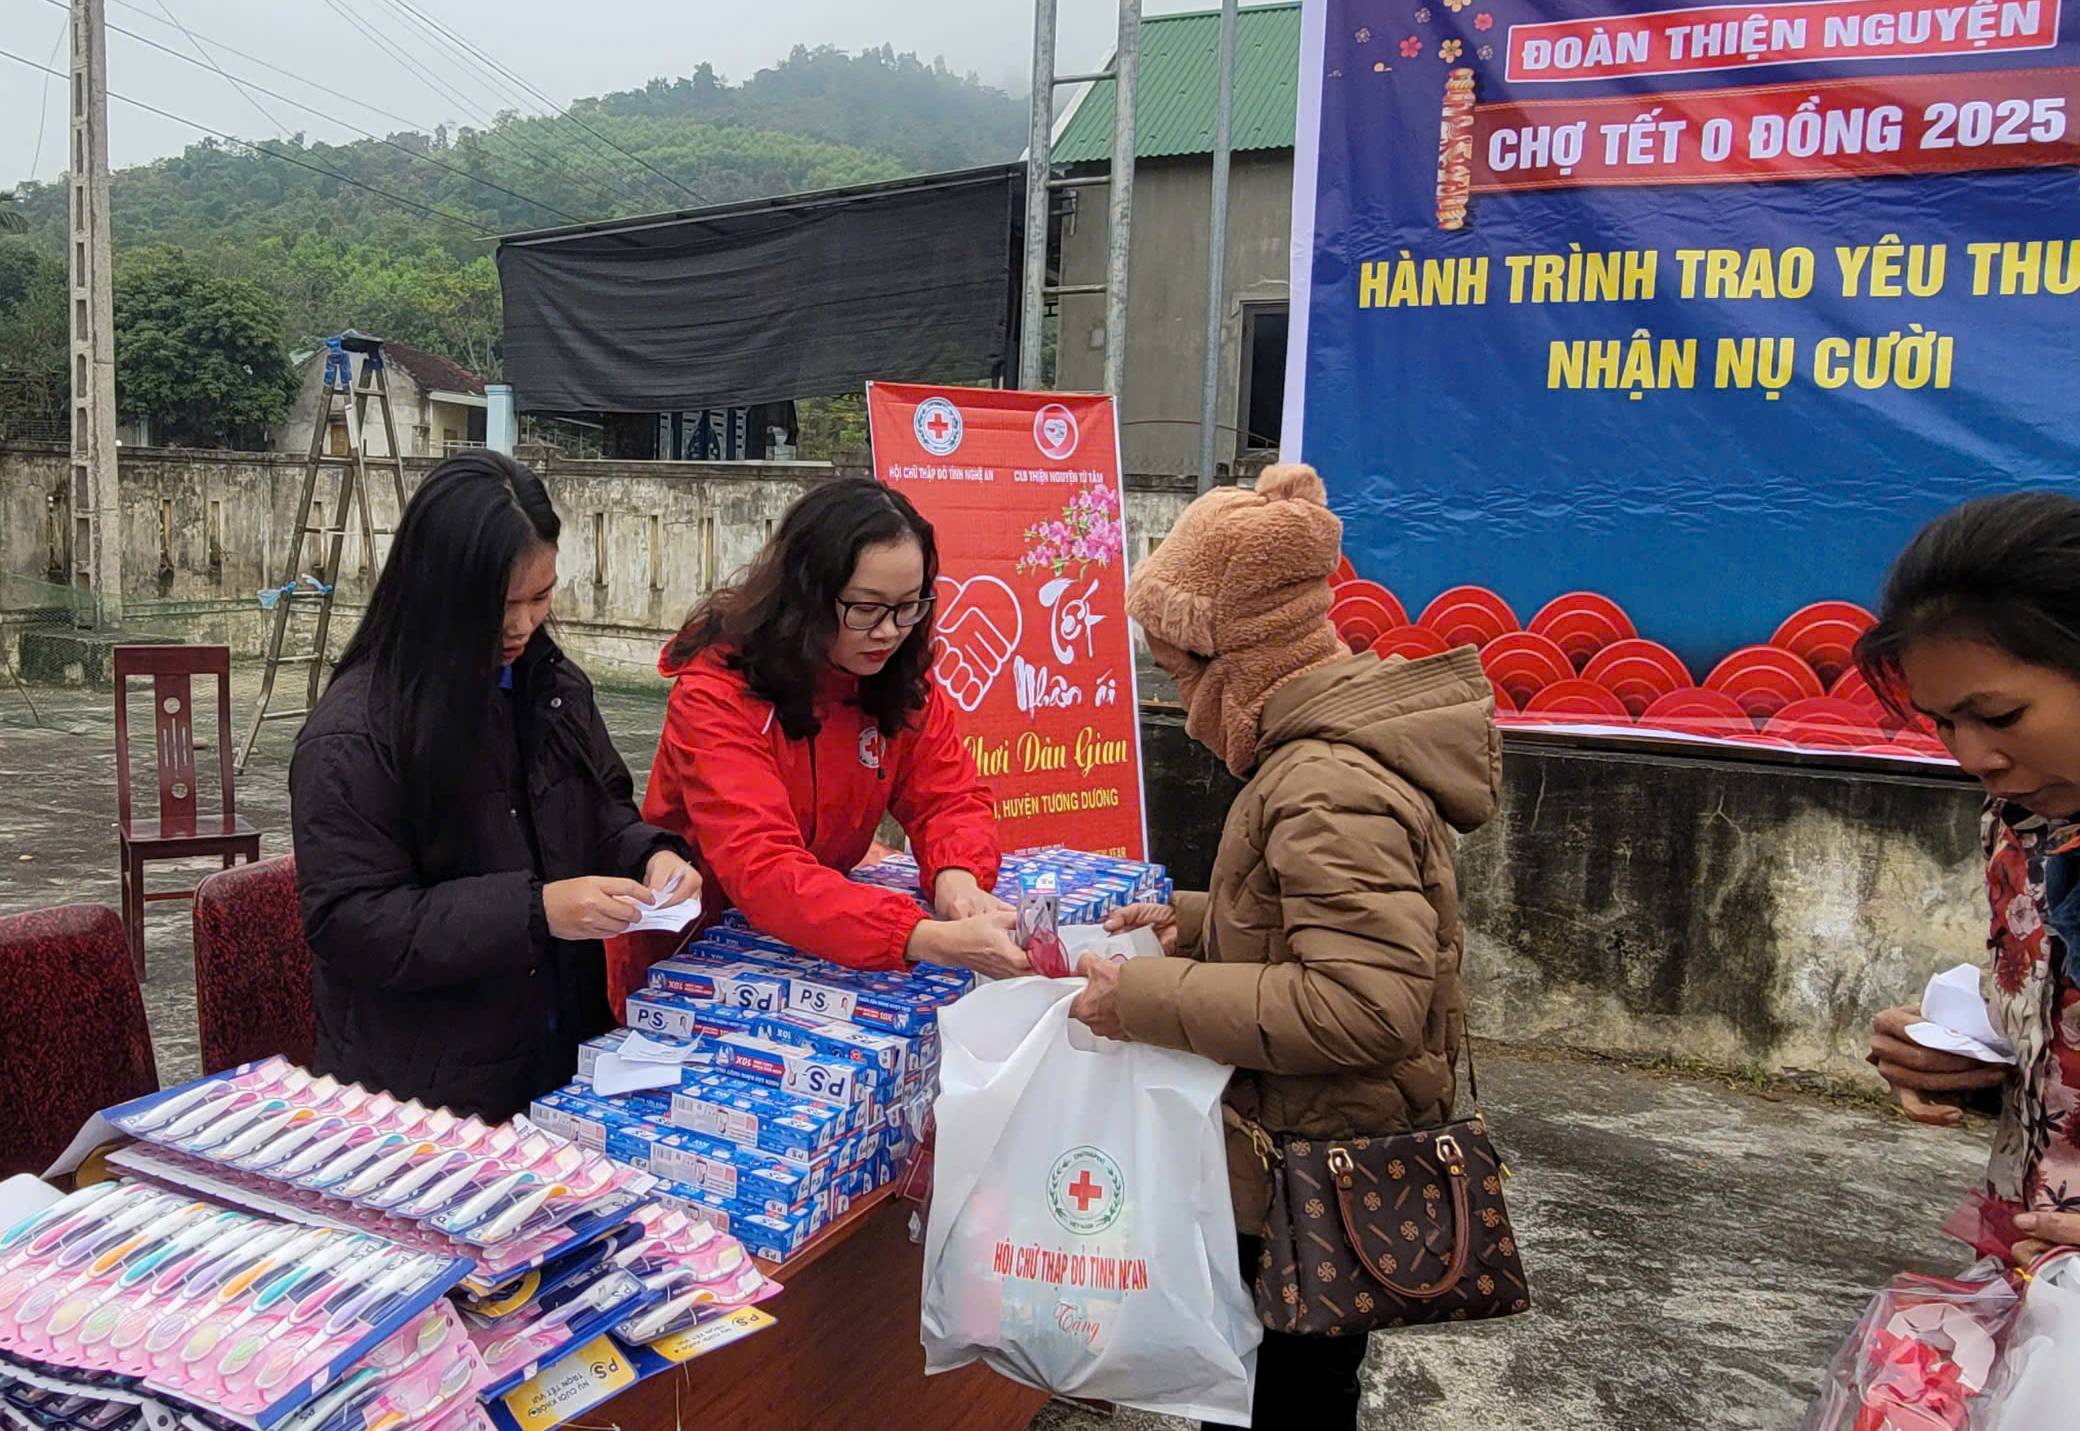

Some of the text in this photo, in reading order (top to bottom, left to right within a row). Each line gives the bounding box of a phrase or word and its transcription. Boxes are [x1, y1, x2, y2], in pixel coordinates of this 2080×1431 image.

[1521, 0, 2040, 70] ĐOÀN THIỆN NGUYỆN
[1488, 121, 1587, 176] CHỢ
[1600, 107, 1687, 165] TẾT
[1749, 95, 1903, 160] ĐỒNG
[1920, 98, 2066, 149] 2025
[1359, 250, 1488, 309] HÀNH
[1508, 242, 1657, 304] TRÌNH
[1675, 246, 1815, 300] TRAO
[1839, 234, 1947, 297] YÊU
[1547, 323, 1954, 400] NHẬN NỤ CƯỜI
[1017, 731, 1066, 774] Dân
[1074, 726, 1128, 778] Gian
[1003, 792, 1039, 819] HUYỆN
[638, 1009, 664, 1027] PS
[738, 988, 773, 1011] PS
[800, 989, 826, 1008] PS
[809, 1070, 846, 1097] PS
[993, 1237, 1014, 1280] HỘI
[1016, 1242, 1040, 1279] CHỮ
[1041, 1246, 1068, 1291] THẬP
[1070, 1245, 1086, 1286] ĐỎ
[593, 1357, 619, 1379] PS
